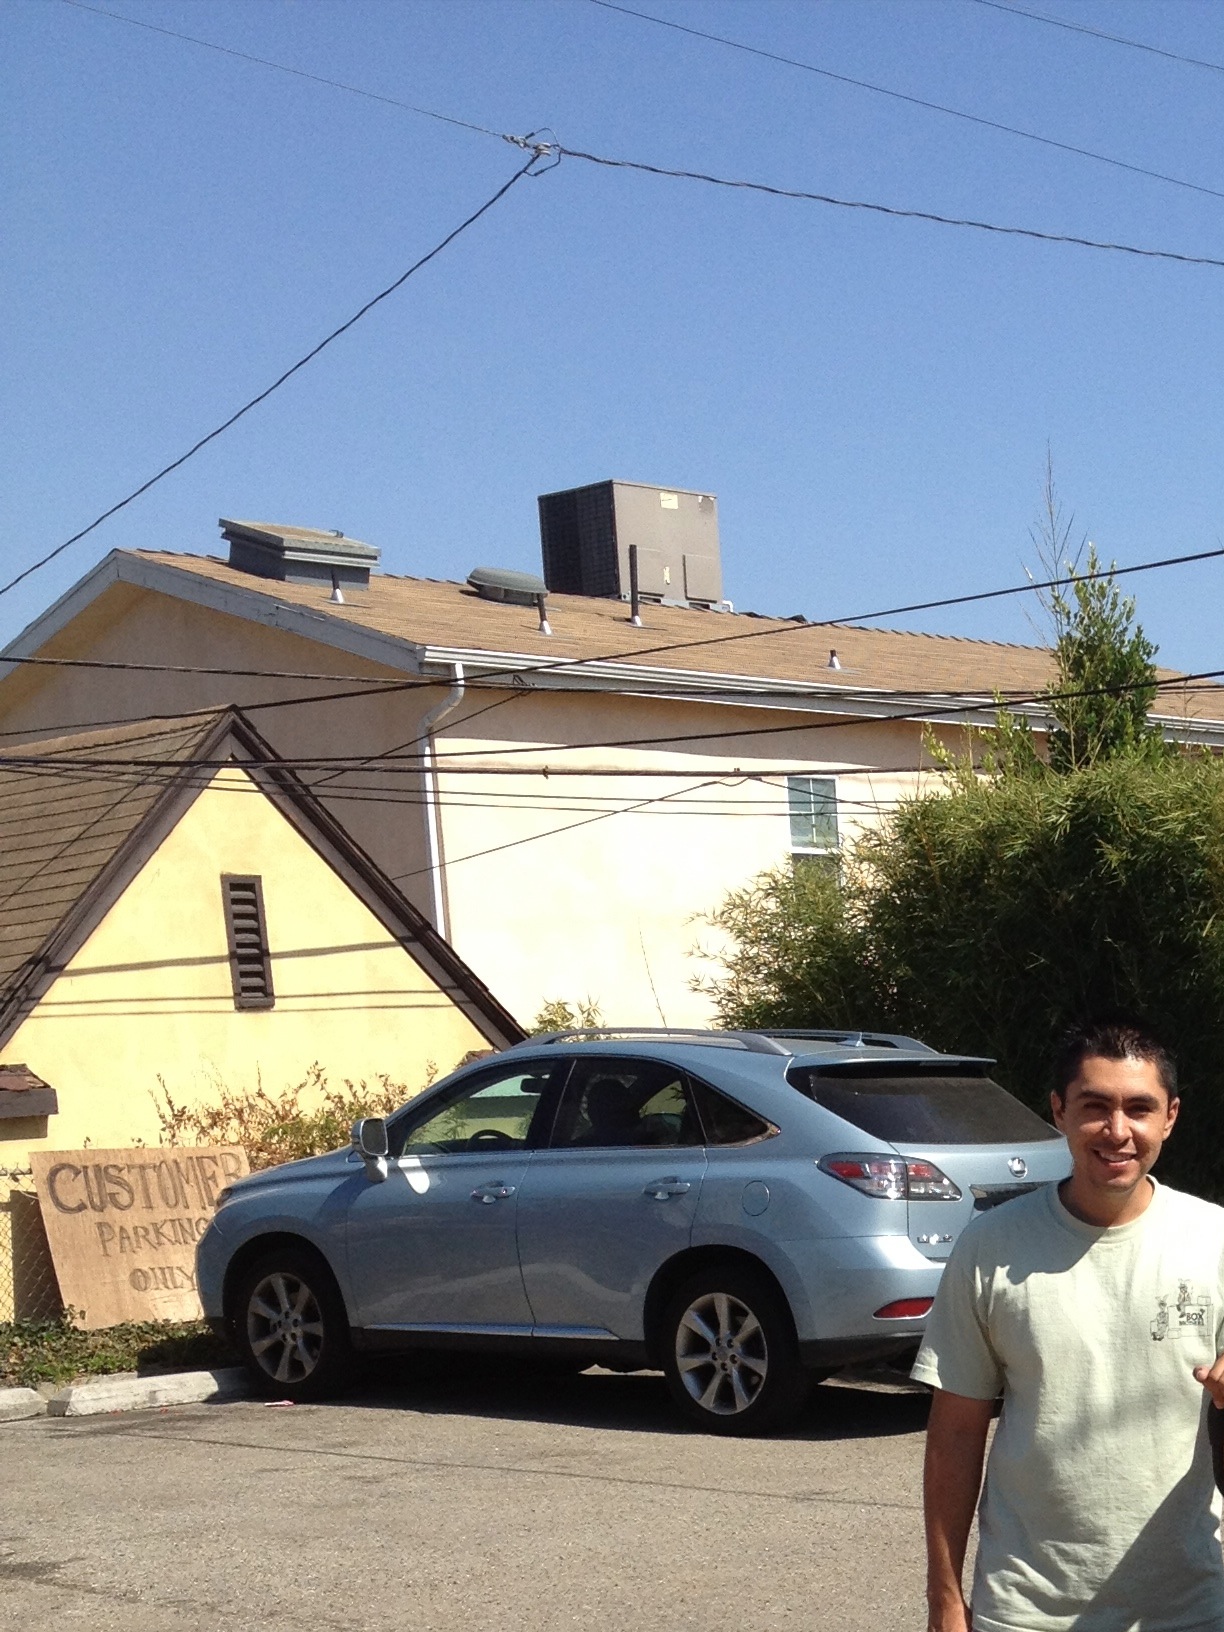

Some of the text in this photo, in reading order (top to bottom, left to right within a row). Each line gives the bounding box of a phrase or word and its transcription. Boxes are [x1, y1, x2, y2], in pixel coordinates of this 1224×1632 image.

[47, 1152, 242, 1214] CUSTOMER
[95, 1217, 208, 1257] PARKING
[130, 1266, 197, 1292] ONLY
[1186, 1312, 1204, 1321] BOX
